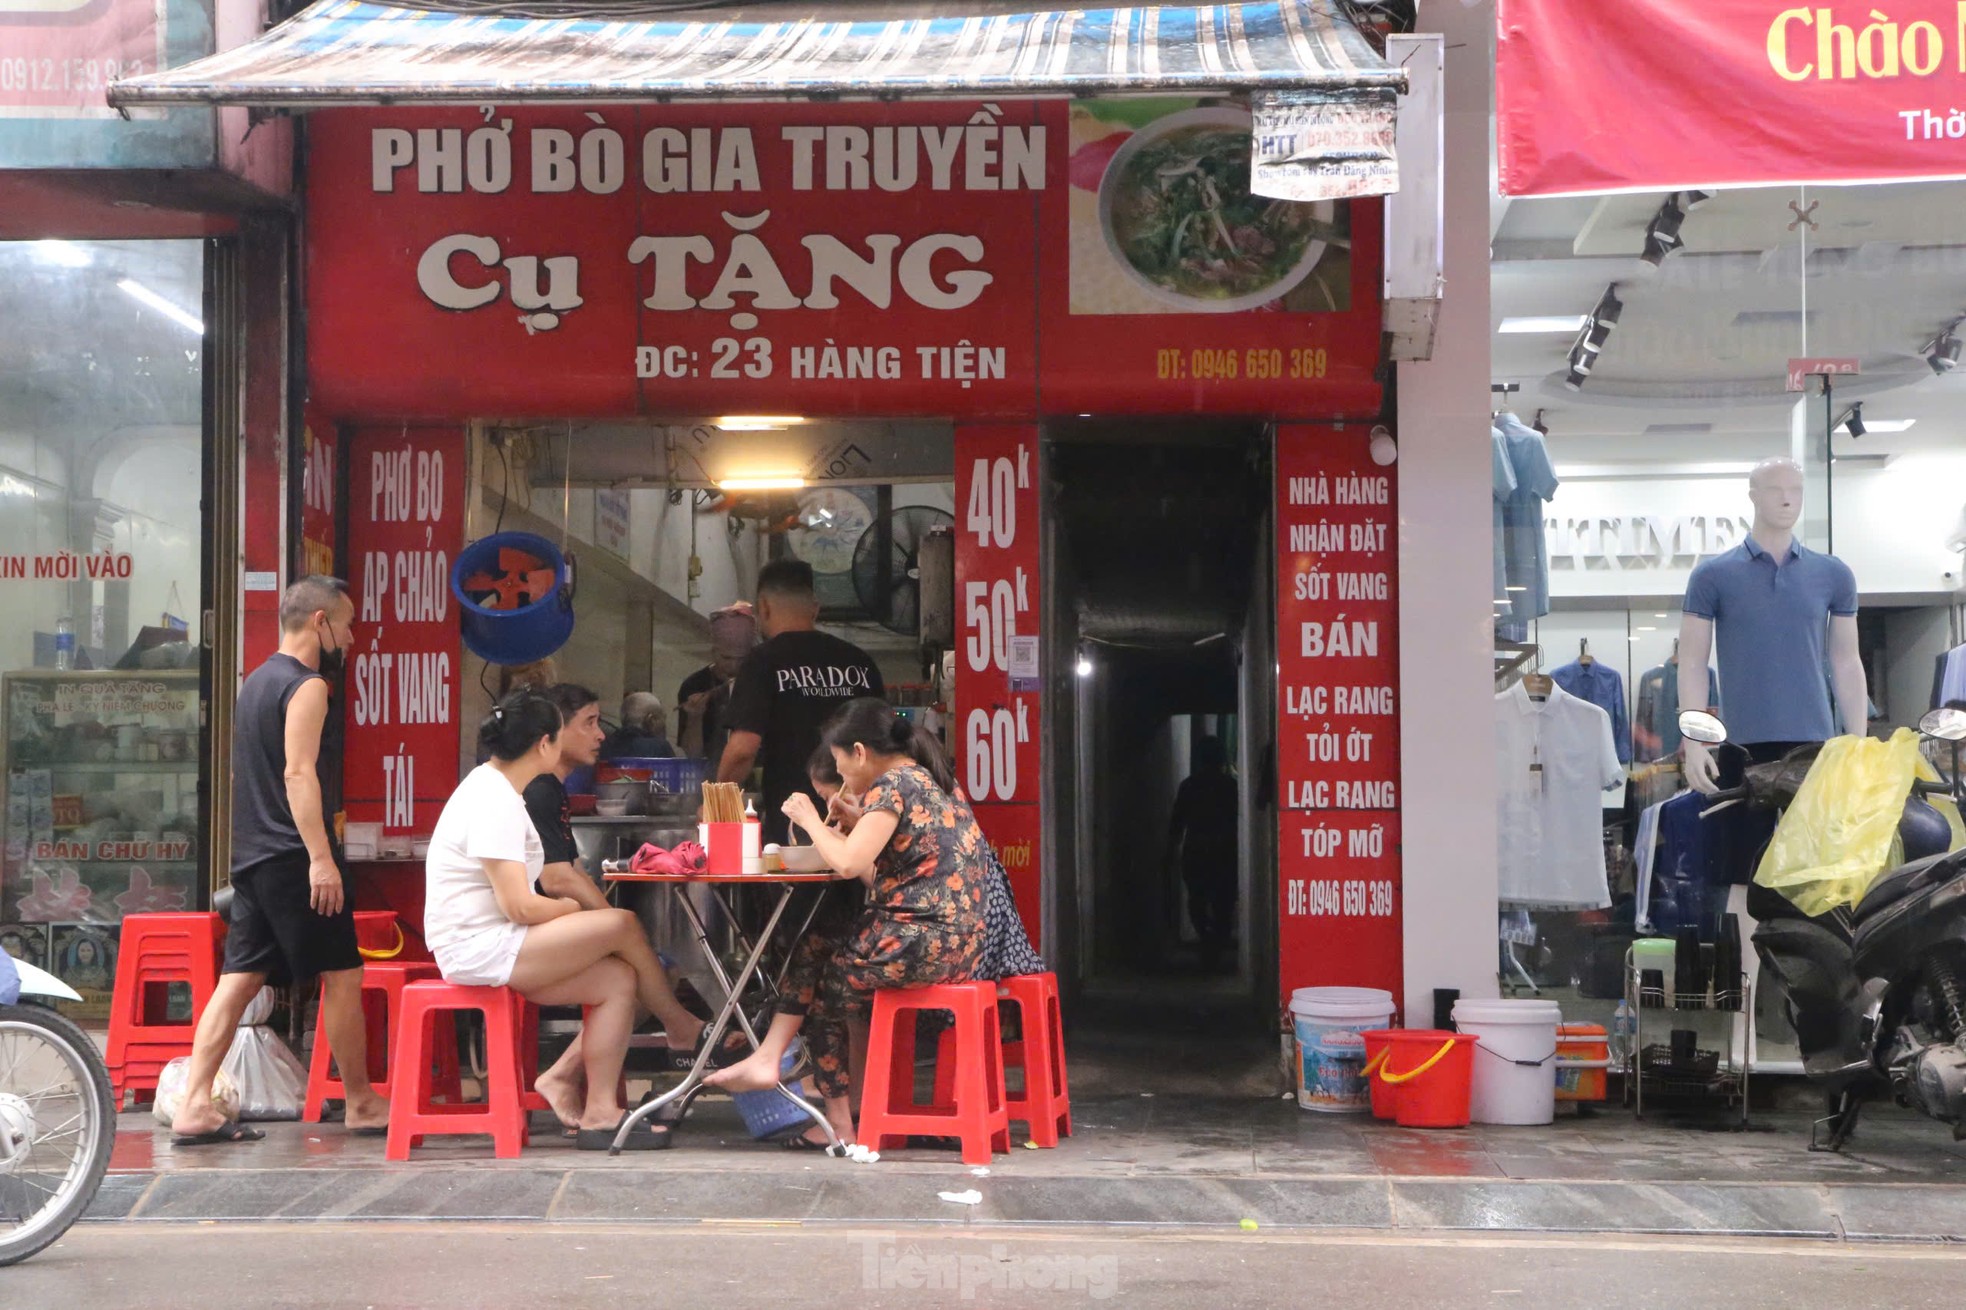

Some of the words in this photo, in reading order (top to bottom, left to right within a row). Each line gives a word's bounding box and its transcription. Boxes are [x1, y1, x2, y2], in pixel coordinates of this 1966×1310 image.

[1766, 8, 1943, 81] Chào
[1898, 108, 1966, 141] Thờ
[372, 104, 513, 194] PHỞ
[531, 112, 625, 194] BÒ
[643, 127, 762, 193] GIA
[781, 103, 1047, 192] TRUYỀN
[1262, 134, 1297, 155] HTT
[417, 233, 584, 332] Cụ
[627, 209, 994, 331] TẶNG
[635, 346, 699, 379] ĐC:
[711, 337, 774, 379] 23
[791, 339, 901, 379] HÀNG
[916, 339, 1006, 388] TIỆN
[1192, 349, 1238, 379] 0946
[1246, 349, 1282, 379] 650
[1290, 349, 1327, 379] 369
[1289, 470, 1329, 505] NHÀ
[1335, 470, 1388, 505] HÀNG
[1290, 518, 1344, 558] NHẬN
[1349, 518, 1387, 558] ĐẶT
[34, 550, 78, 579] MỜI
[86, 550, 132, 579] VÀO
[395, 526, 447, 623] CHẢO
[1295, 562, 1331, 601] SỐT
[1337, 572, 1388, 601] VANG
[1301, 613, 1378, 657] BÁN
[355, 626, 393, 726] SỐT
[398, 651, 450, 725] VANG
[776, 664, 871, 692] PARADOX
[1286, 686, 1328, 721] LẠC
[1334, 686, 1394, 715] RANG
[1306, 722, 1340, 762] TỎI
[1346, 726, 1373, 762] ỚT
[383, 742, 414, 827] TÁI
[1288, 780, 1329, 816] LẠC
[1335, 780, 1395, 810] RANG
[1002, 837, 1031, 867] mời
[1301, 822, 1342, 858] TÓP
[1348, 823, 1384, 858] MỠ
[1288, 879, 1307, 916] ĐT:
[1309, 879, 1340, 916] 0946
[1343, 879, 1366, 917] 650
[1369, 880, 1393, 917] 369
[675, 1057, 718, 1068] CHAEL
